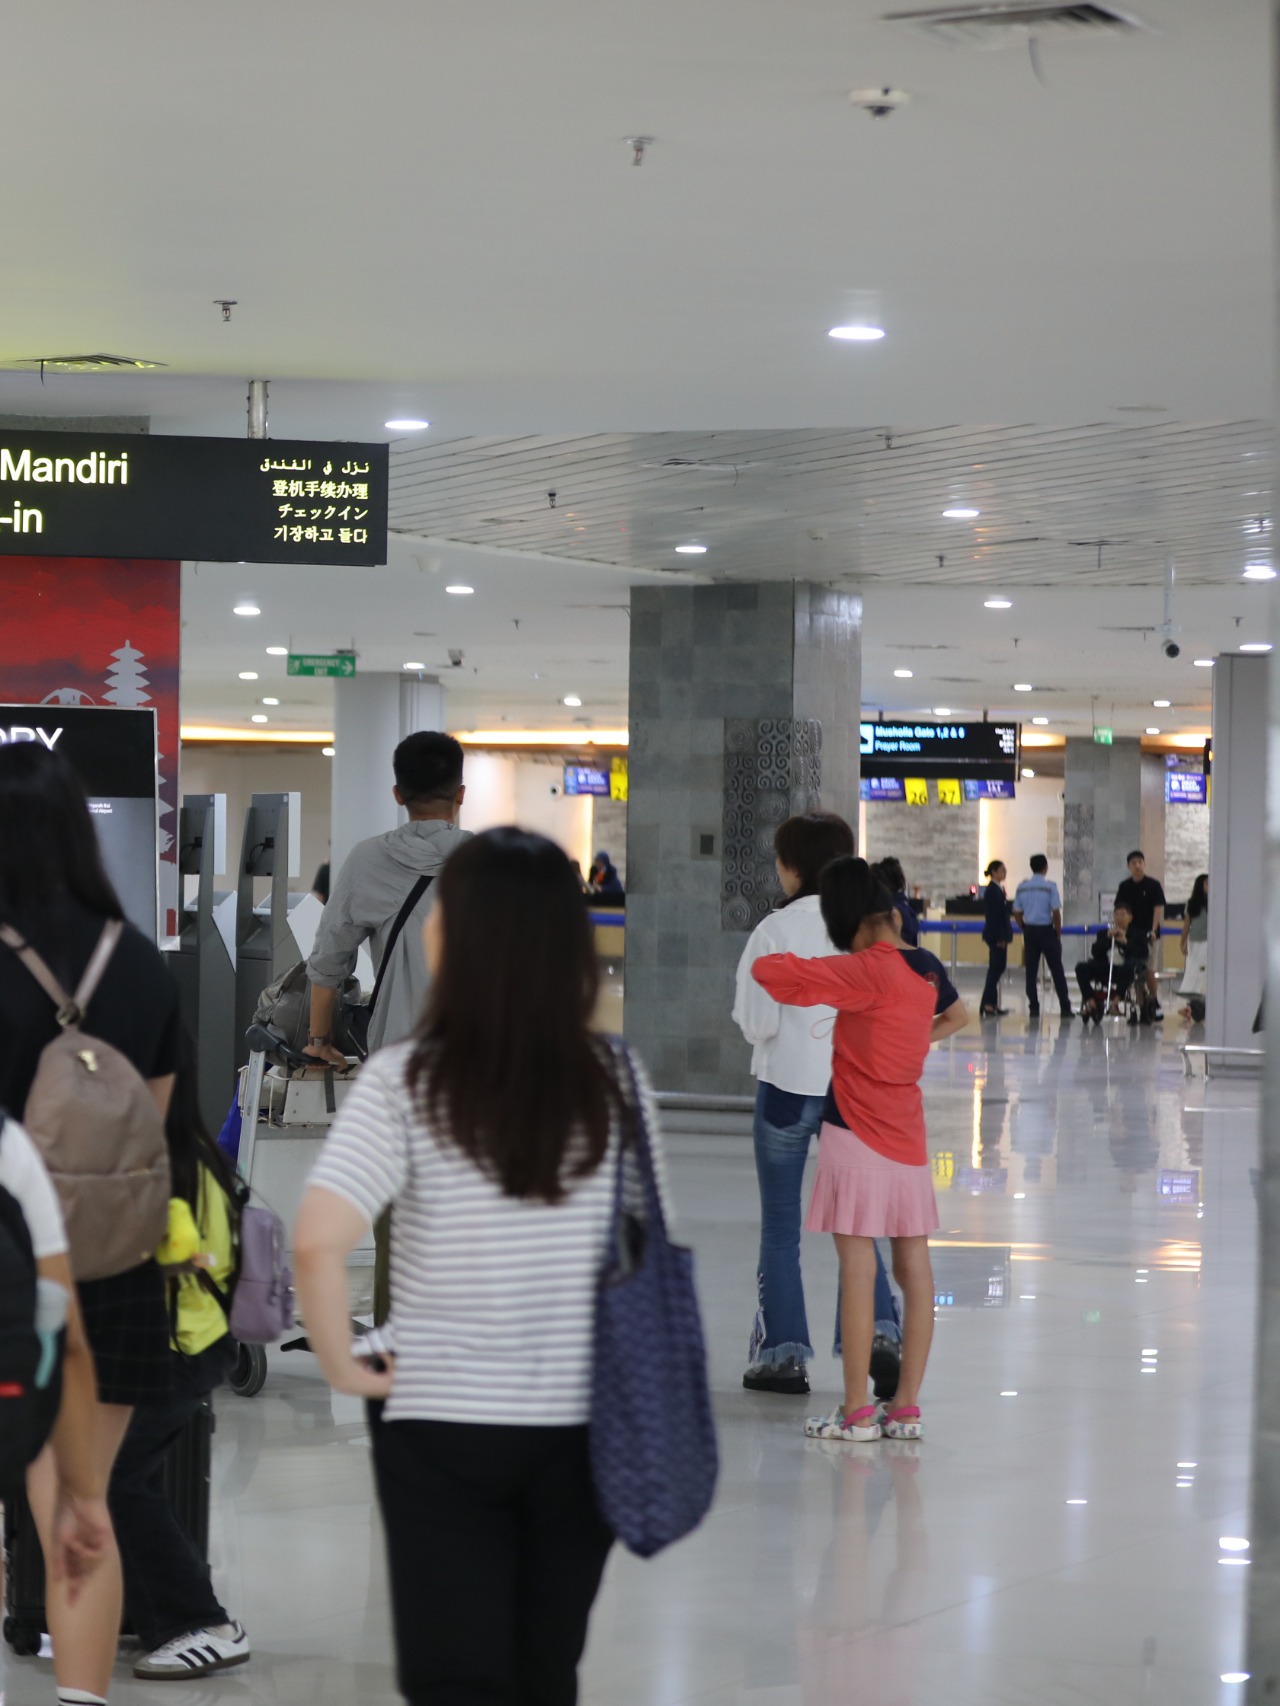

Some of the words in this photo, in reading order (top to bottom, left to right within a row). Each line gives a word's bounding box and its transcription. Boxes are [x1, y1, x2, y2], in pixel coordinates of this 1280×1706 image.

[0, 449, 128, 485] Mandiri
[272, 479, 369, 500] 登机手续办理
[278, 503, 369, 520] チェックイン
[273, 525, 334, 543] 기장하고
[875, 740, 898, 752] Prayer
[899, 740, 921, 752] Room
